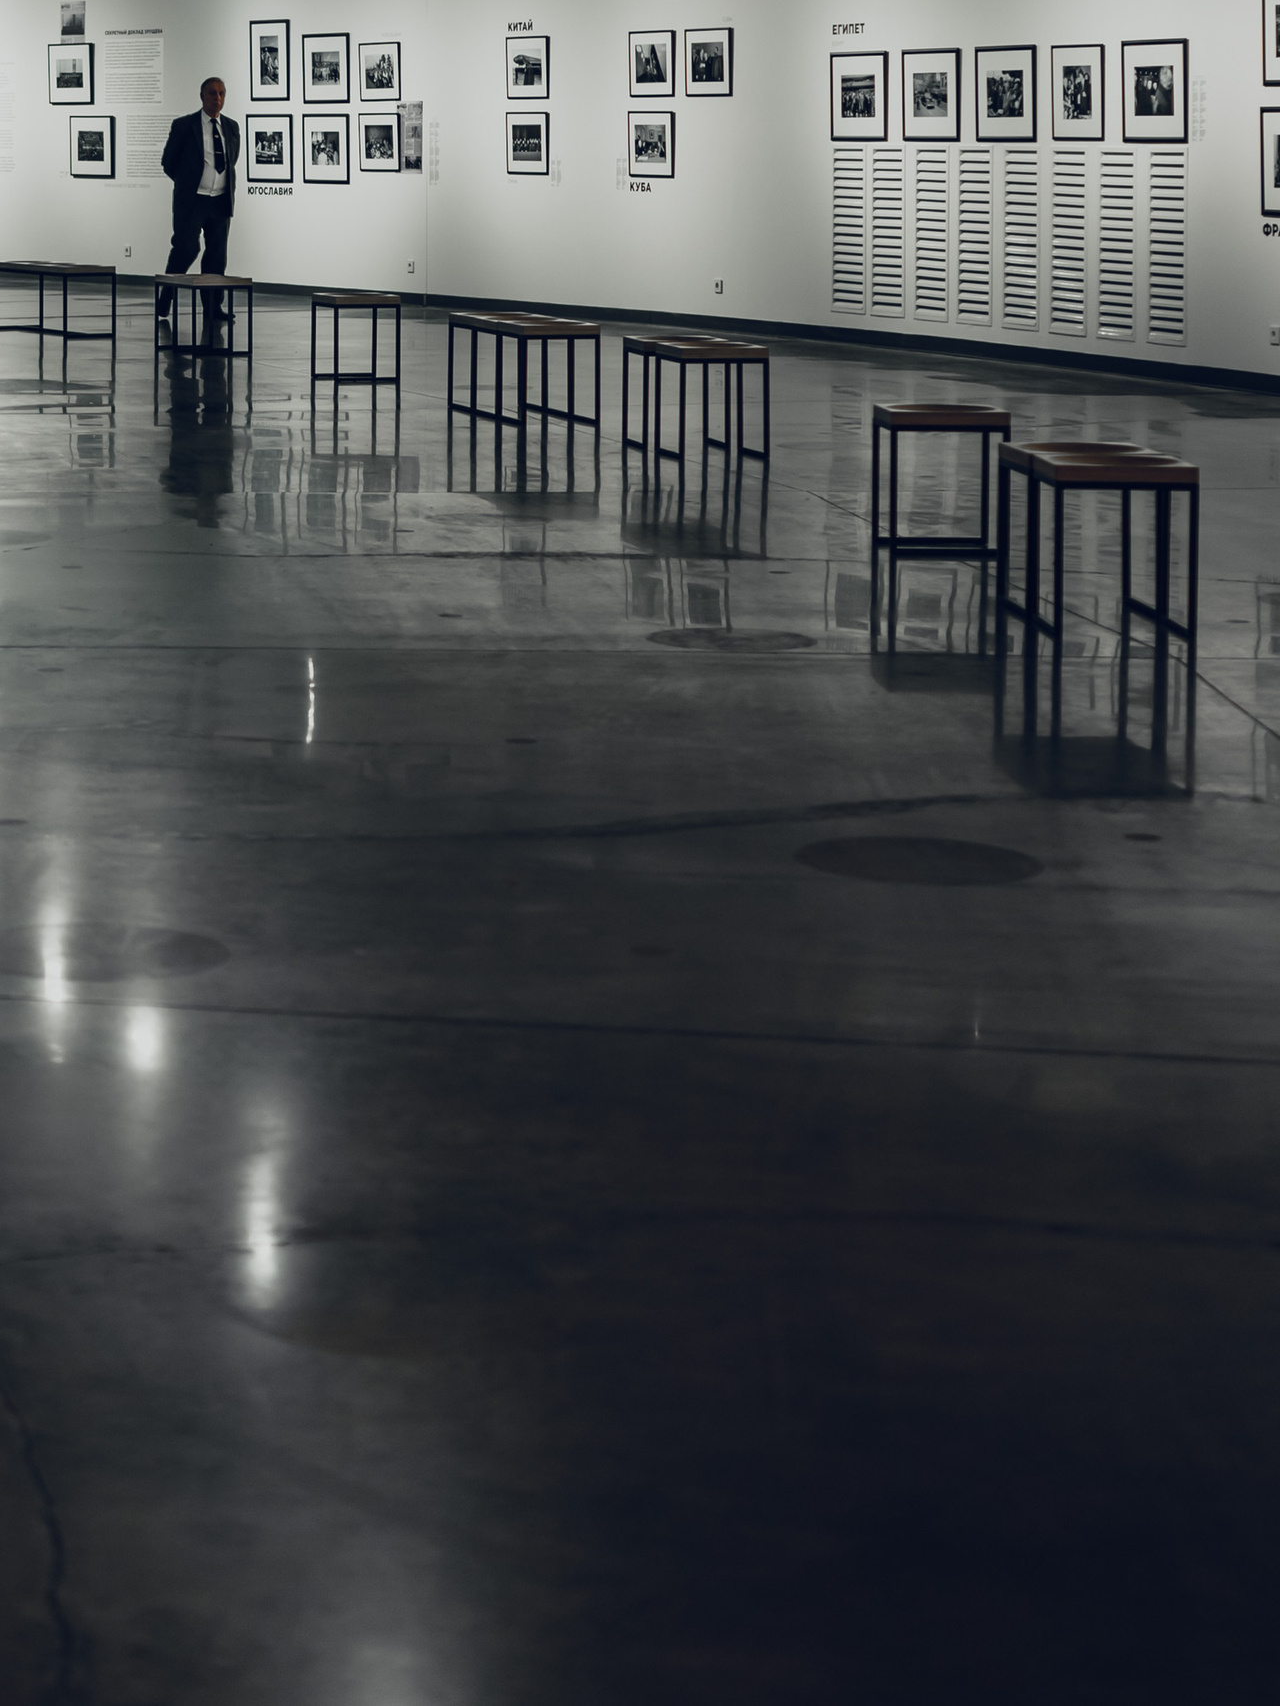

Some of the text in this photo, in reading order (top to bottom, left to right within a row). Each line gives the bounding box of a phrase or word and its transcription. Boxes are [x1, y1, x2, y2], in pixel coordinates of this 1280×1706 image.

[507, 19, 533, 32] КИТАЙ
[832, 23, 865, 35] ЕГИПЕТ
[247, 186, 293, 196] ЮГОСЛАВИЯ
[629, 181, 651, 193] КУБА
[1262, 222, 1280, 237] ФР
